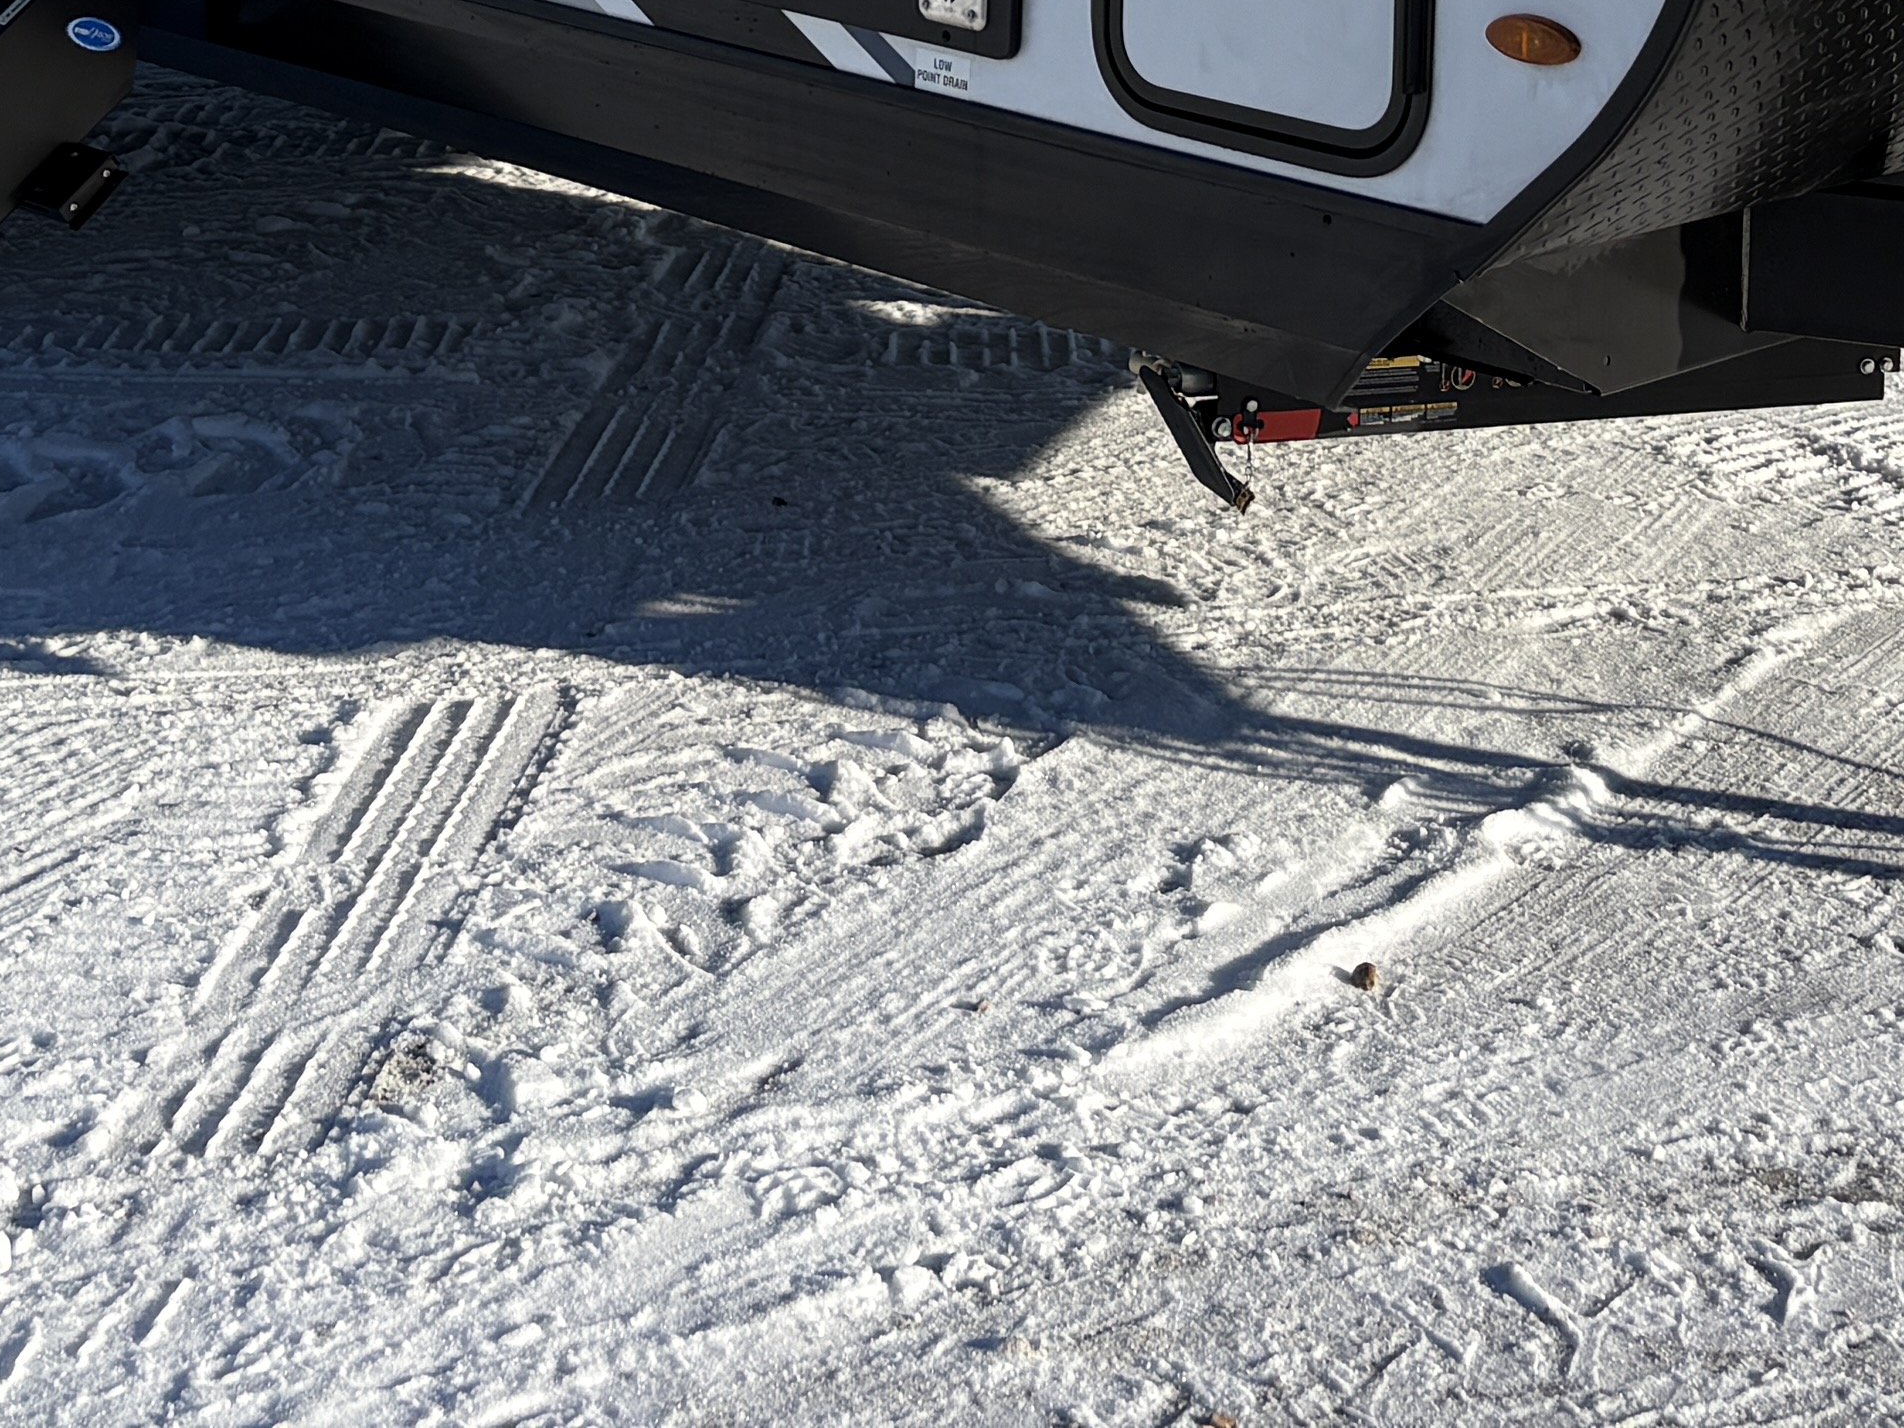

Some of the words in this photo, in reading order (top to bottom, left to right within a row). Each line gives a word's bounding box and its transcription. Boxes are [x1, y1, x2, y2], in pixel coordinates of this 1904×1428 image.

[933, 58, 953, 72] LOW
[917, 69, 941, 84] POINT
[943, 75, 968, 91] DRAIN
